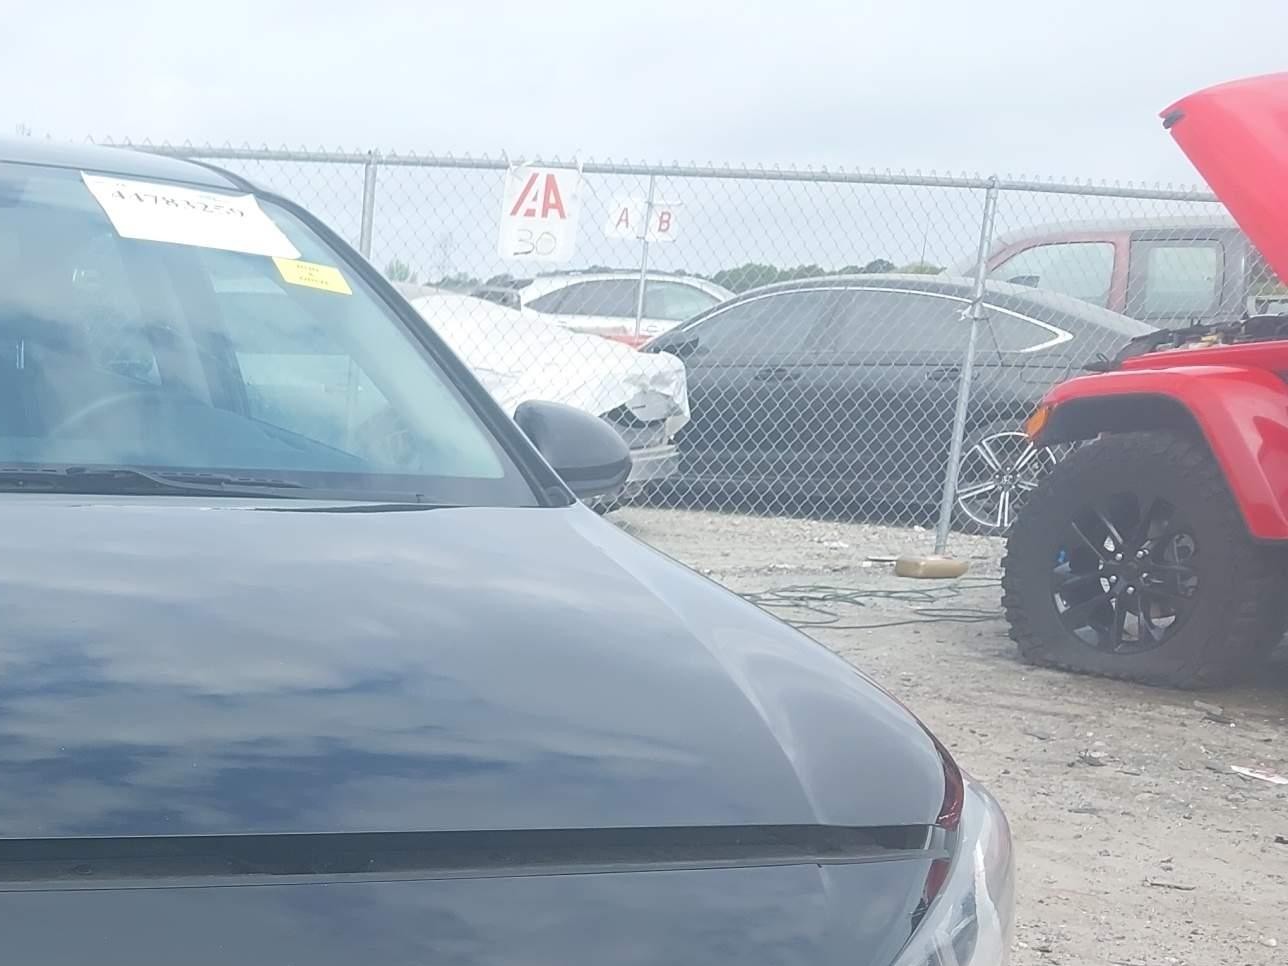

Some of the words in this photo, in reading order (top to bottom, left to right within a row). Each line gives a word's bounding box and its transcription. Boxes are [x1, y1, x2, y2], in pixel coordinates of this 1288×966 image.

[615, 206, 630, 230] A
[657, 211, 672, 233] B
[513, 228, 557, 257] 30
